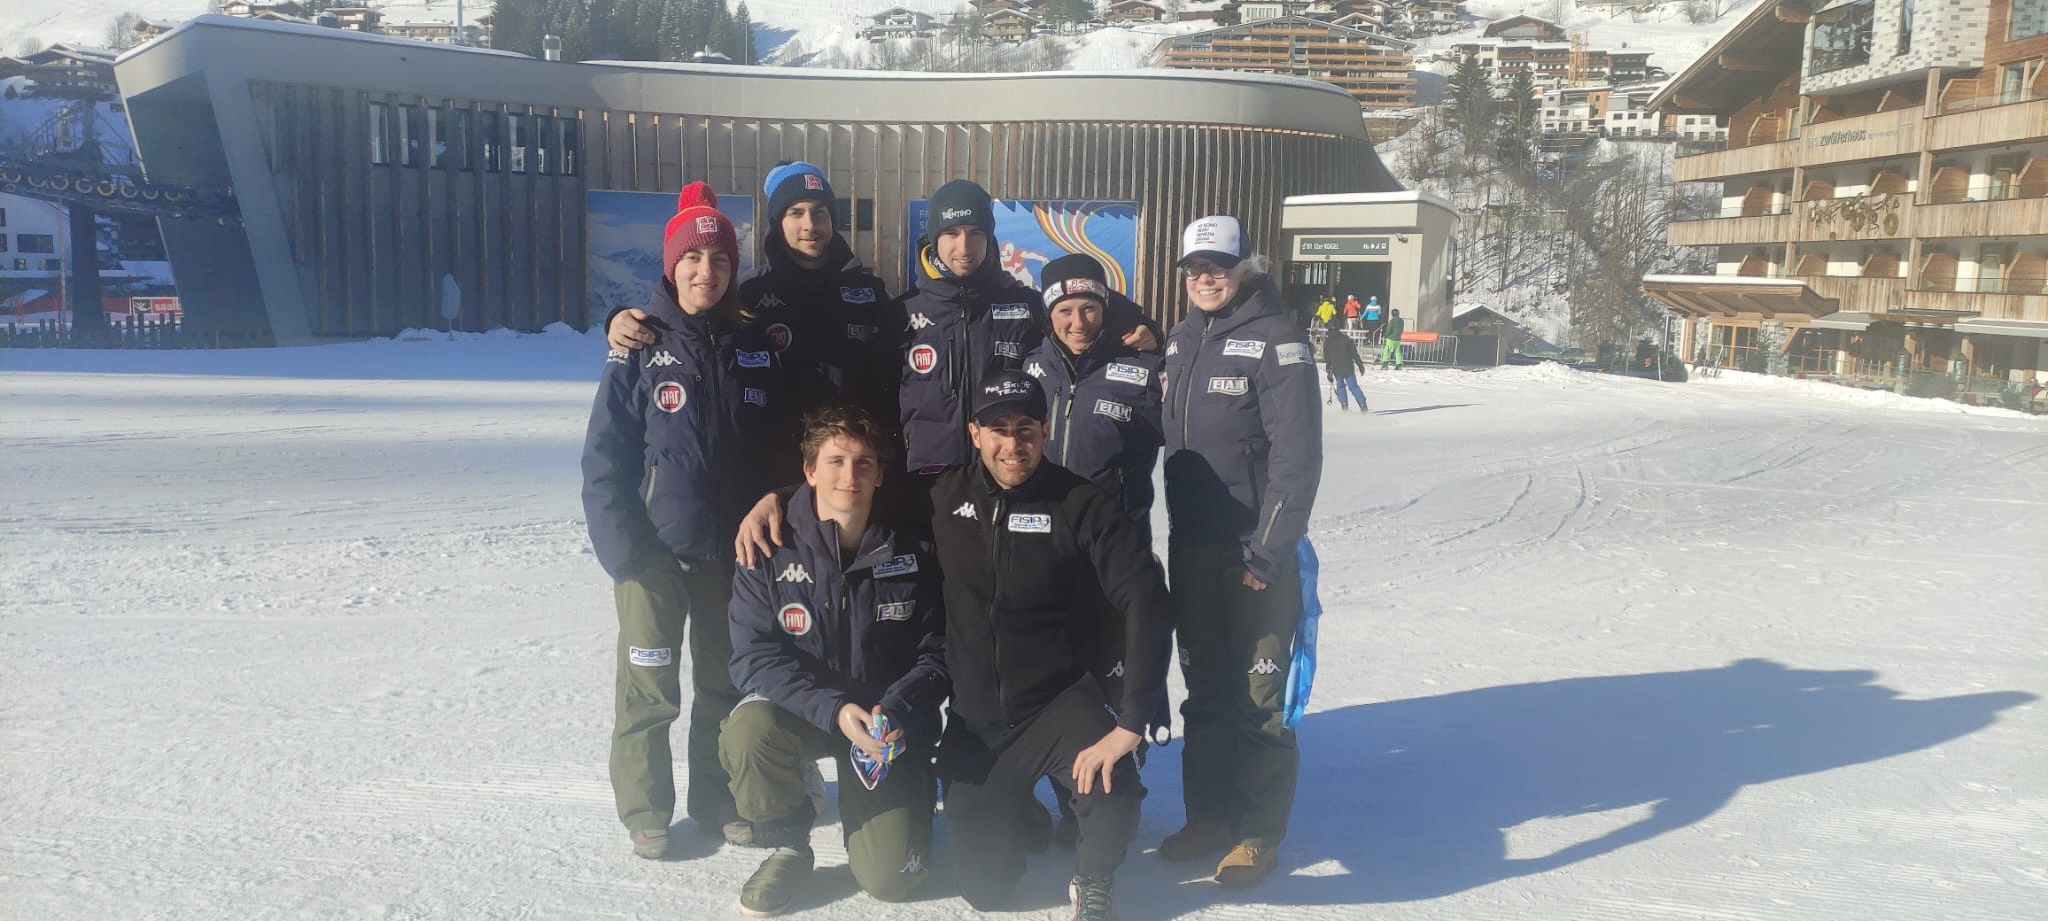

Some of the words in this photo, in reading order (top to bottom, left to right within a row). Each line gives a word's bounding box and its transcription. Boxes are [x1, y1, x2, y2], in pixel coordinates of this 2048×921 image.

[915, 352, 932, 367] FIAT
[661, 390, 680, 405] FIAT
[785, 613, 805, 628] FIAT
